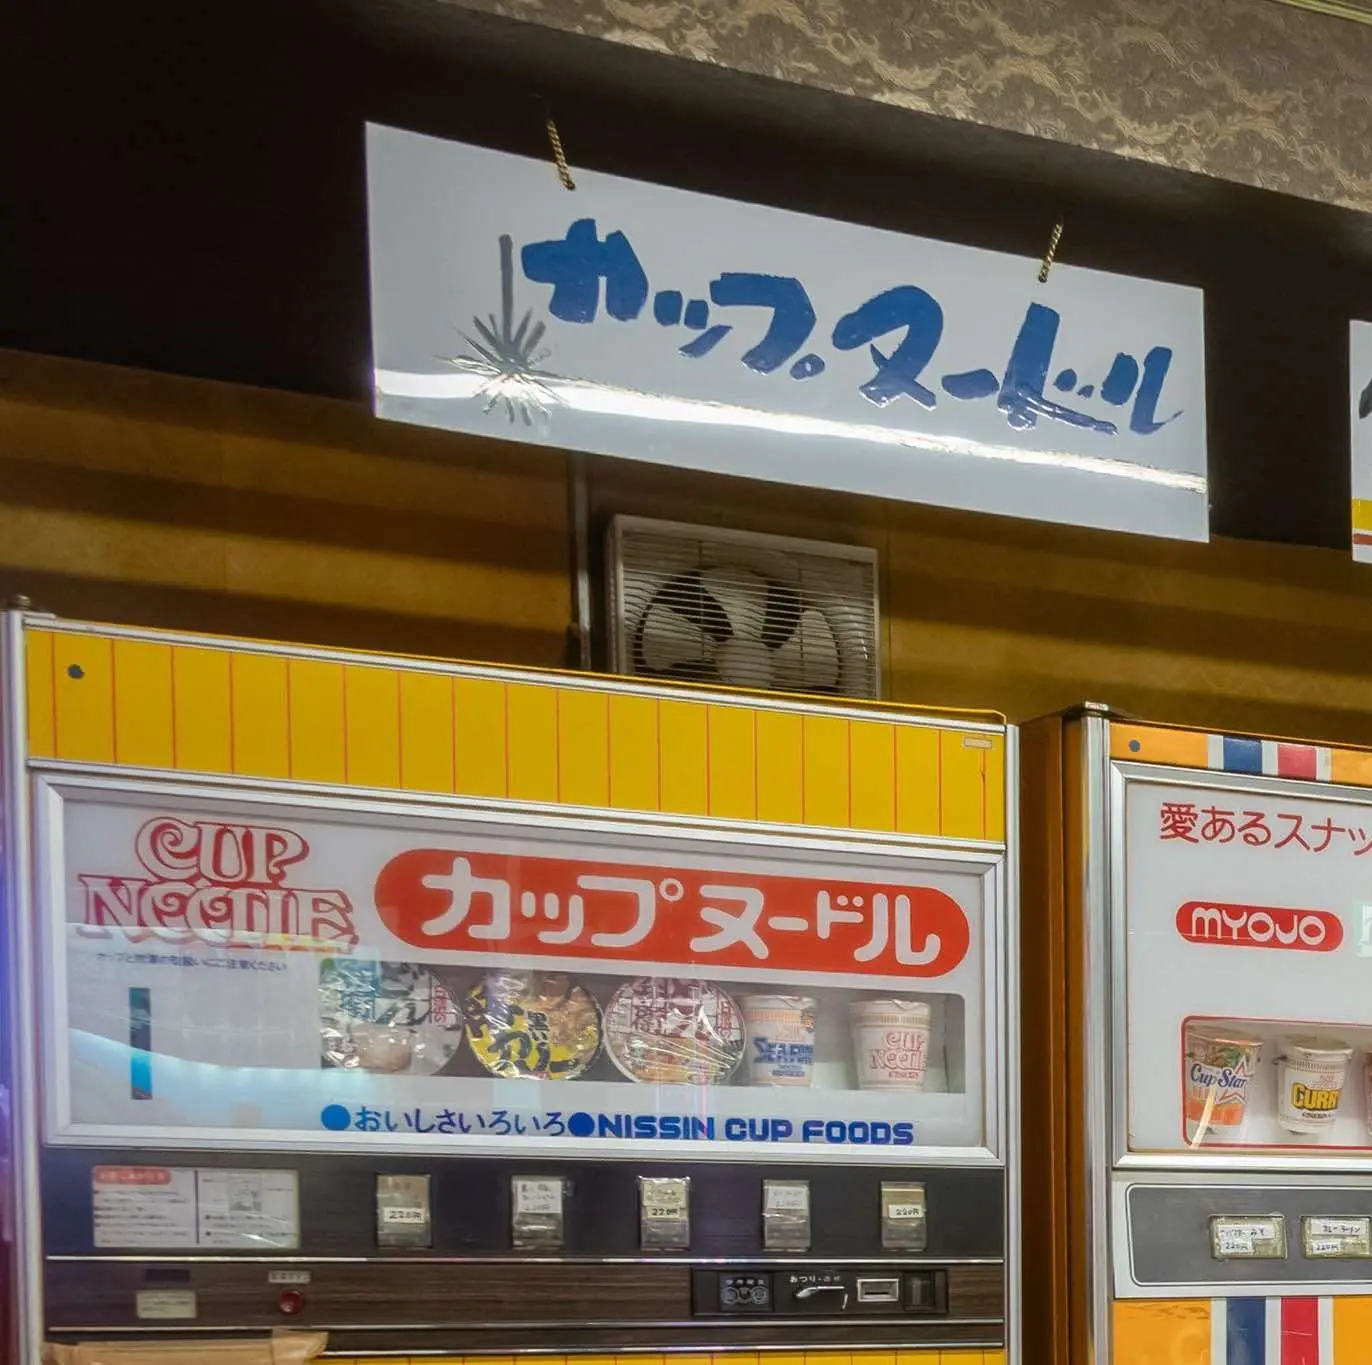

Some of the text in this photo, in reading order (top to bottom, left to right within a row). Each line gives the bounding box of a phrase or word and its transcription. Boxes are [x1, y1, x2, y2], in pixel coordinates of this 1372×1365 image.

[521, 218, 1184, 435] カップヌードル
[135, 816, 310, 885] CUP
[78, 874, 360, 955] NOODLE
[421, 857, 941, 965] カップヌードル
[1191, 906, 1326, 945] MYOJO
[1190, 1063, 1216, 1088] Cup
[355, 1105, 565, 1136] おいしさいろいろ
[597, 1115, 914, 1146] NISSIN CUP FOODS
